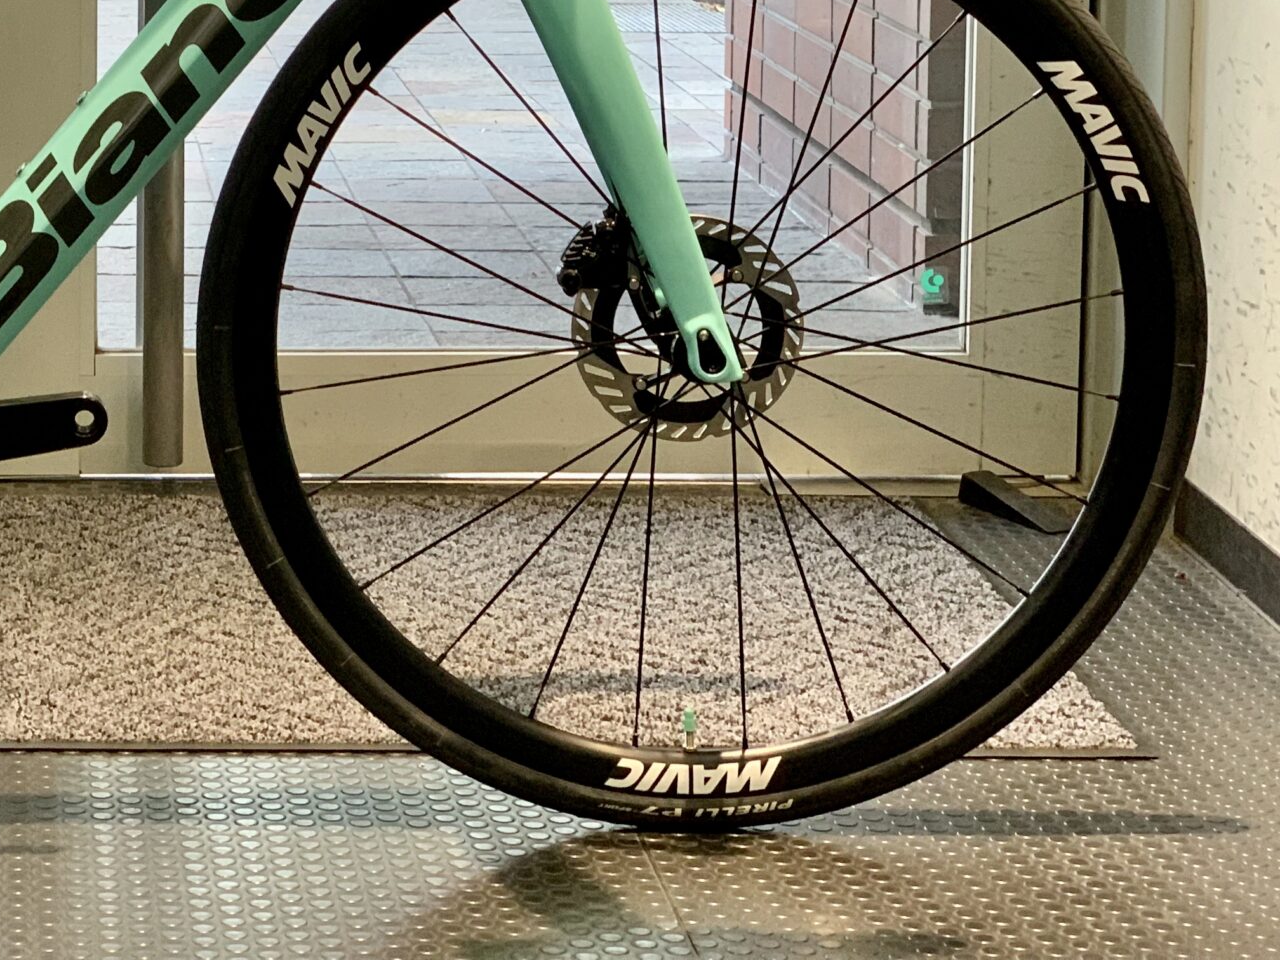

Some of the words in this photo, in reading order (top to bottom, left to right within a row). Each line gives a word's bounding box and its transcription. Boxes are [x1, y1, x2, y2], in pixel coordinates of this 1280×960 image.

[273, 41, 371, 208] MAVIC
[1036, 60, 1150, 203] MAVIC
[604, 756, 782, 795] MAVIC
[642, 806, 682, 817] P7
[695, 798, 794, 818] PIRELLI
